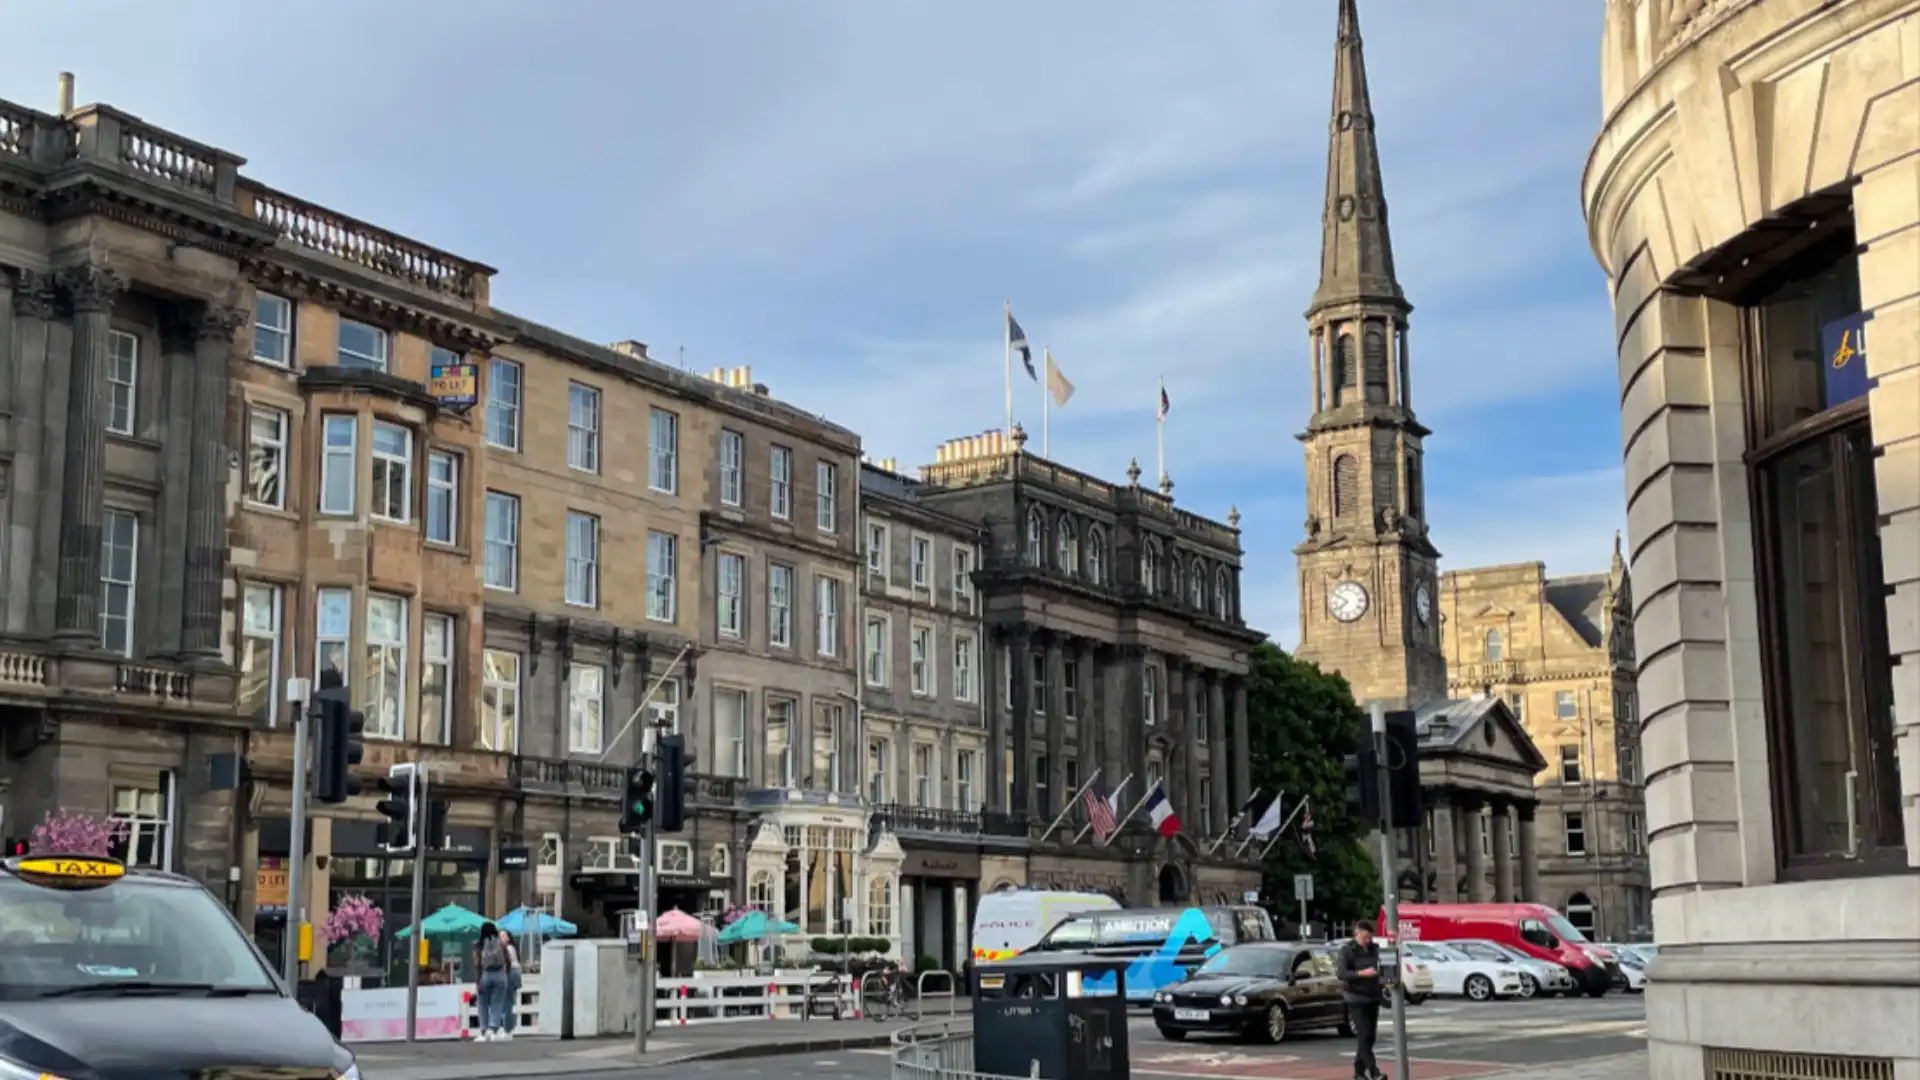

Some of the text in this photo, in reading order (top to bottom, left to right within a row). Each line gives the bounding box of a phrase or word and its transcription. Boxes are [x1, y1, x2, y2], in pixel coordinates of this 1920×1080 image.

[53, 862, 107, 874] TAXI
[980, 921, 1034, 930] POLICE
[1104, 918, 1171, 933] AMBITION
[1004, 1006, 1032, 1017] LITTER
